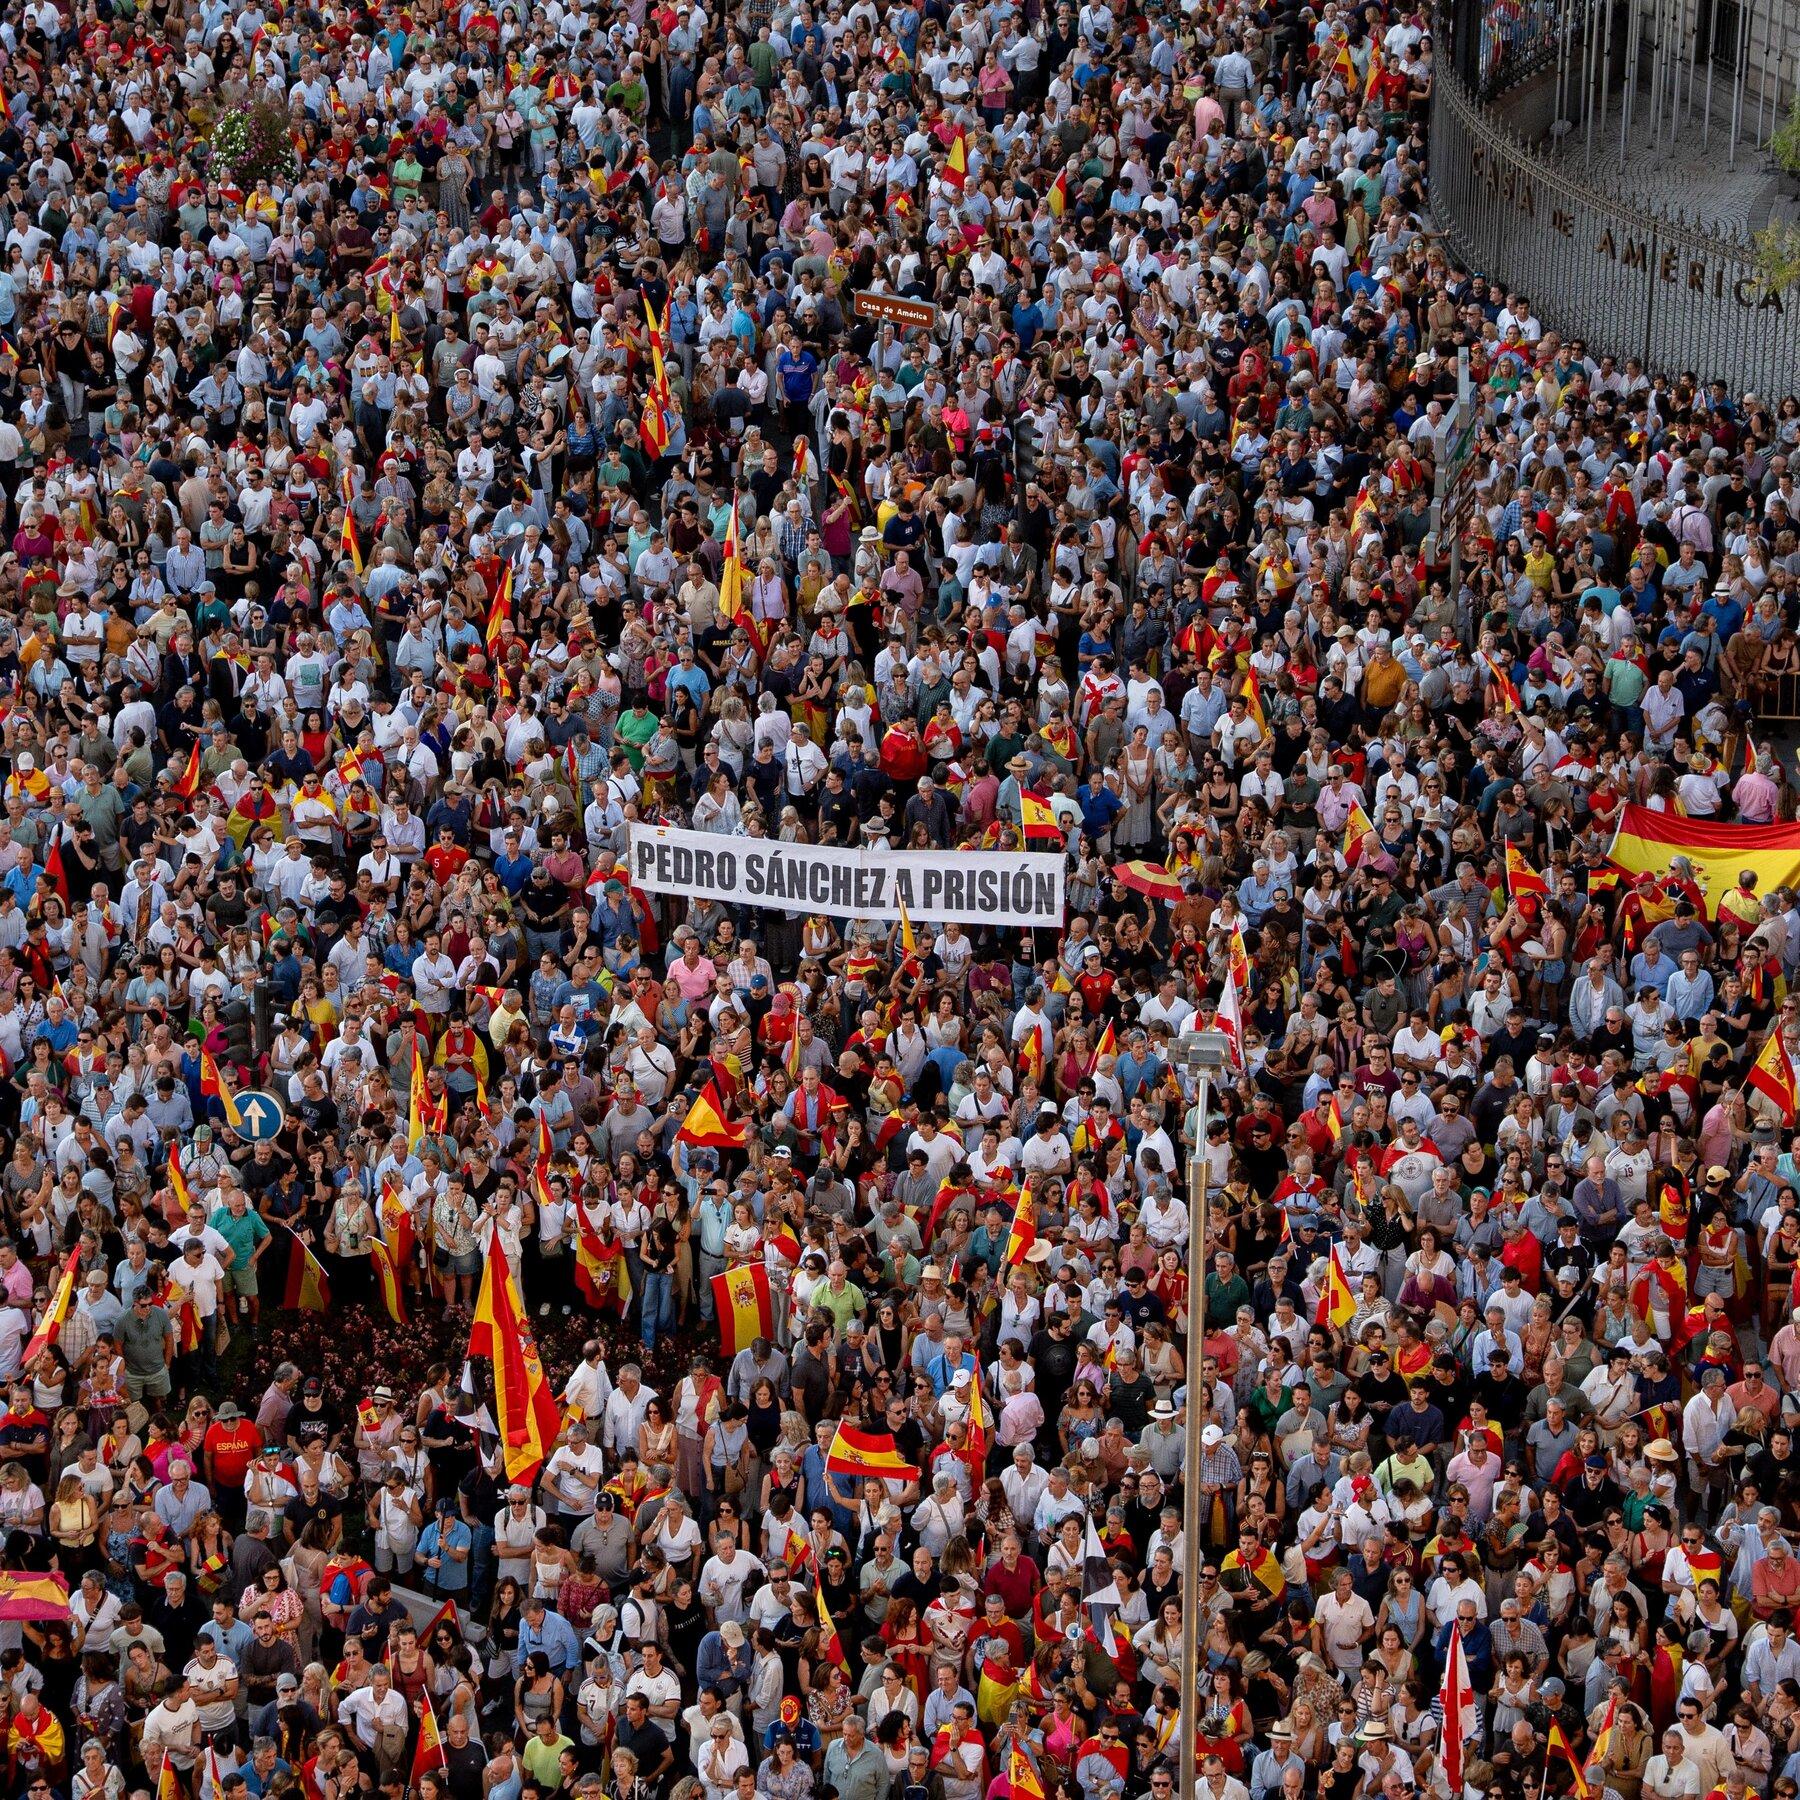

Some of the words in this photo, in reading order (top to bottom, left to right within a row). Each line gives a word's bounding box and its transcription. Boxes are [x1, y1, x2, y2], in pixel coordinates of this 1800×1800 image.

[861, 301, 881, 312] Casa
[884, 306, 894, 314] de
[897, 308, 928, 321] América
[434, 858, 440, 868] 5
[637, 841, 737, 891] PEDRO
[745, 850, 886, 908] SÁNCHEZ
[893, 868, 915, 908] A
[923, 863, 1055, 915] PRISIÓN
[1363, 1081, 1386, 1093] VANS
[1624, 1166, 1634, 1178] 19
[217, 1439, 249, 1451] ESPAÑA
[589, 1699, 596, 1711] 7
